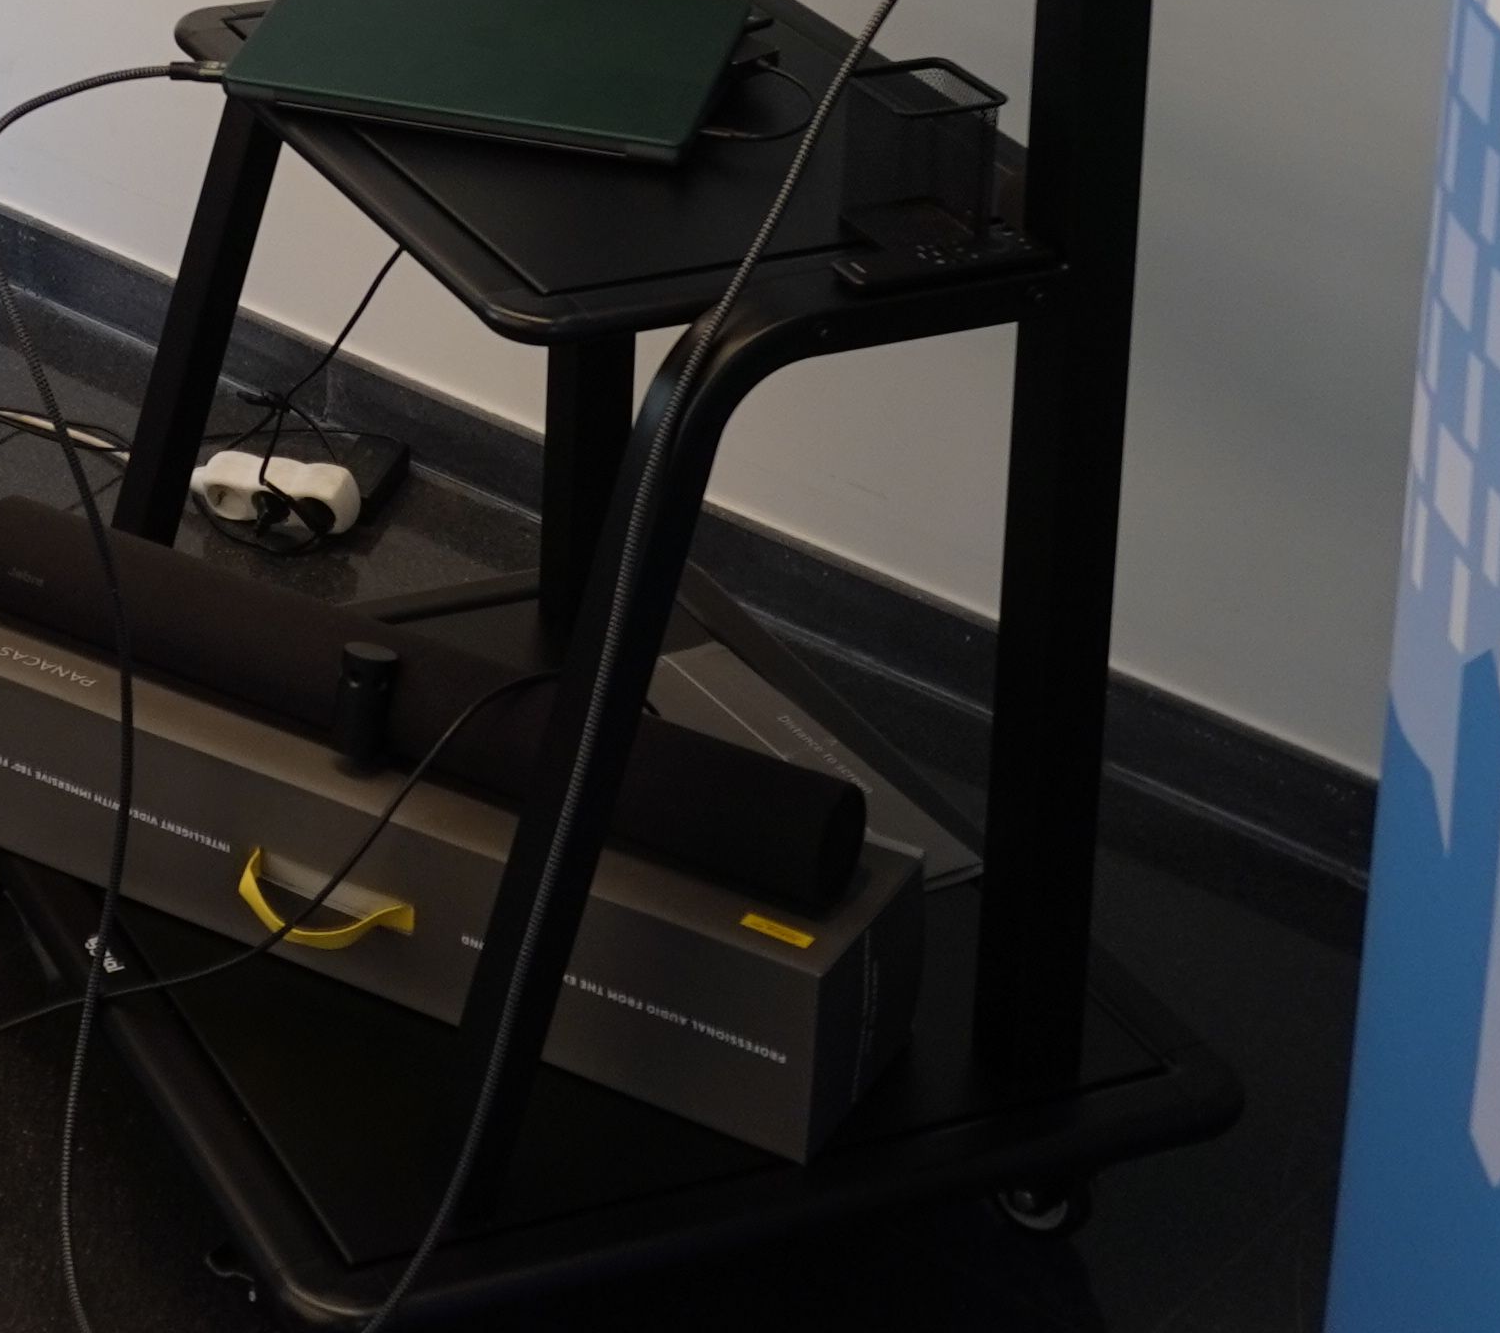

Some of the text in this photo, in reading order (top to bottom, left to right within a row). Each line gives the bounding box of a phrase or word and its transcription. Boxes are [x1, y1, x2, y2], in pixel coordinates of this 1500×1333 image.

[776, 713, 824, 753] Distance
[33, 771, 92, 800] IMMERSIVE
[159, 819, 231, 853] INTELLIGENT
[578, 976, 605, 996] THE
[605, 986, 643, 1011] FROM
[645, 1002, 689, 1027] AUDIO
[689, 1017, 788, 1065] PROFESSIONAL
